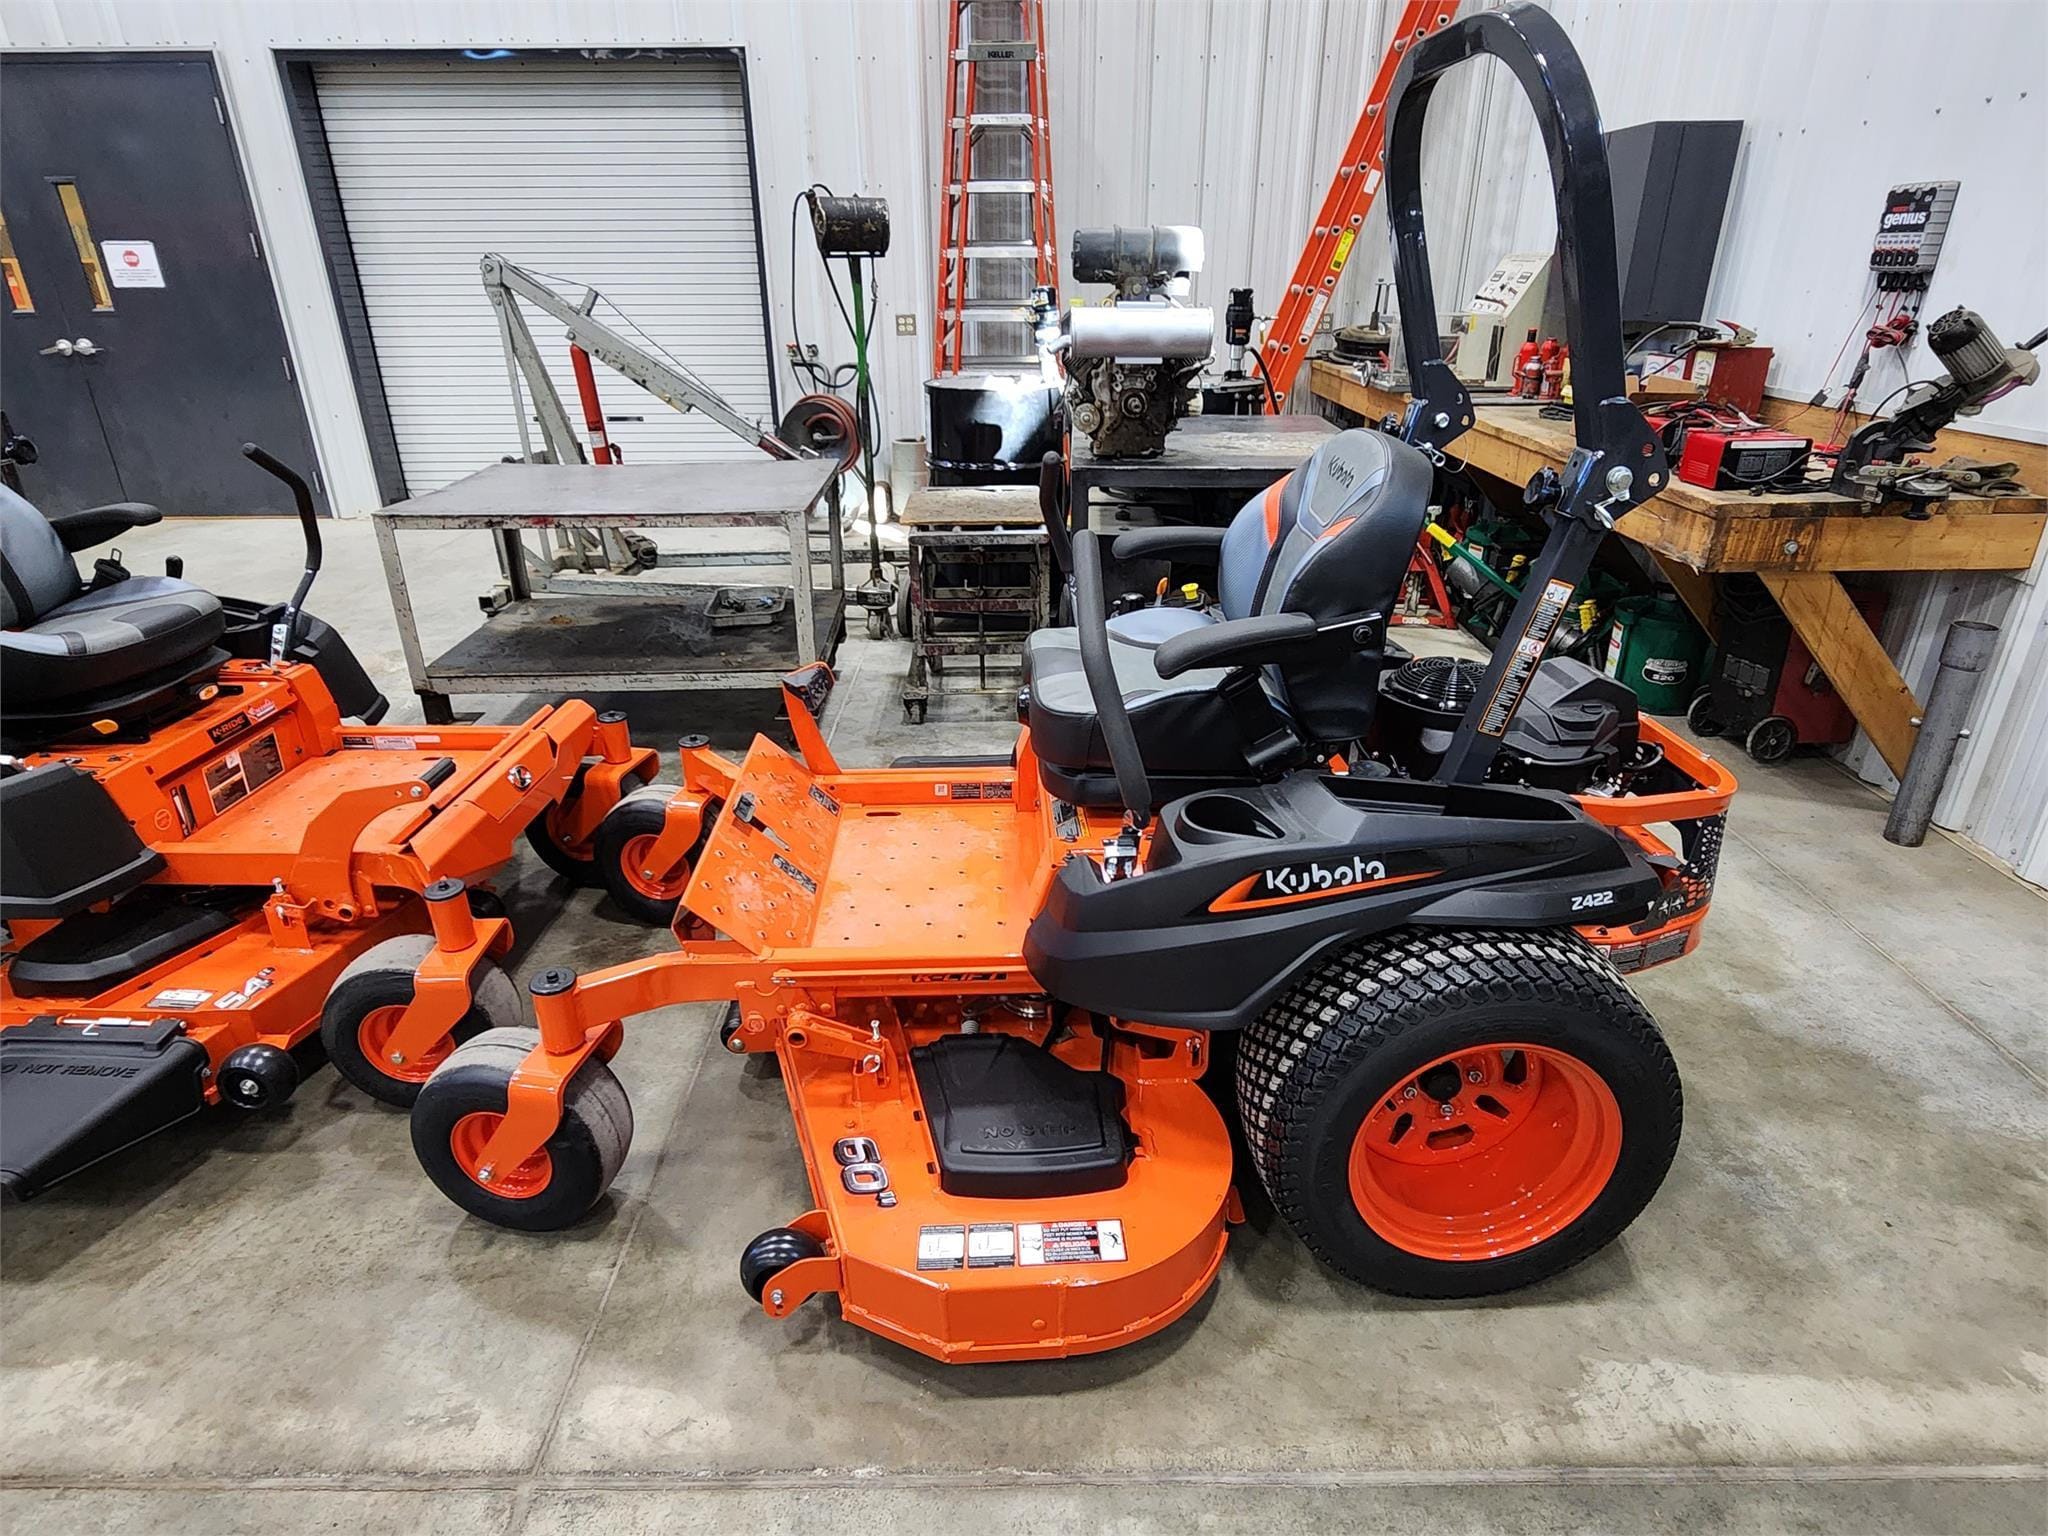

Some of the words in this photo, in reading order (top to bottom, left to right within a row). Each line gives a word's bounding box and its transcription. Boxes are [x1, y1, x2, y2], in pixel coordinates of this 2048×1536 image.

[987, 50, 1015, 59] KELLER
[1883, 211, 1927, 229] genius
[1328, 454, 1355, 489] Kubota
[212, 714, 246, 738] K-RIDE
[1265, 855, 1387, 894] Kubota
[1571, 890, 1615, 911] Z422
[20, 1063, 63, 1074] NOT
[60, 1065, 141, 1079] REMOVE
[982, 1126, 1015, 1139] NO
